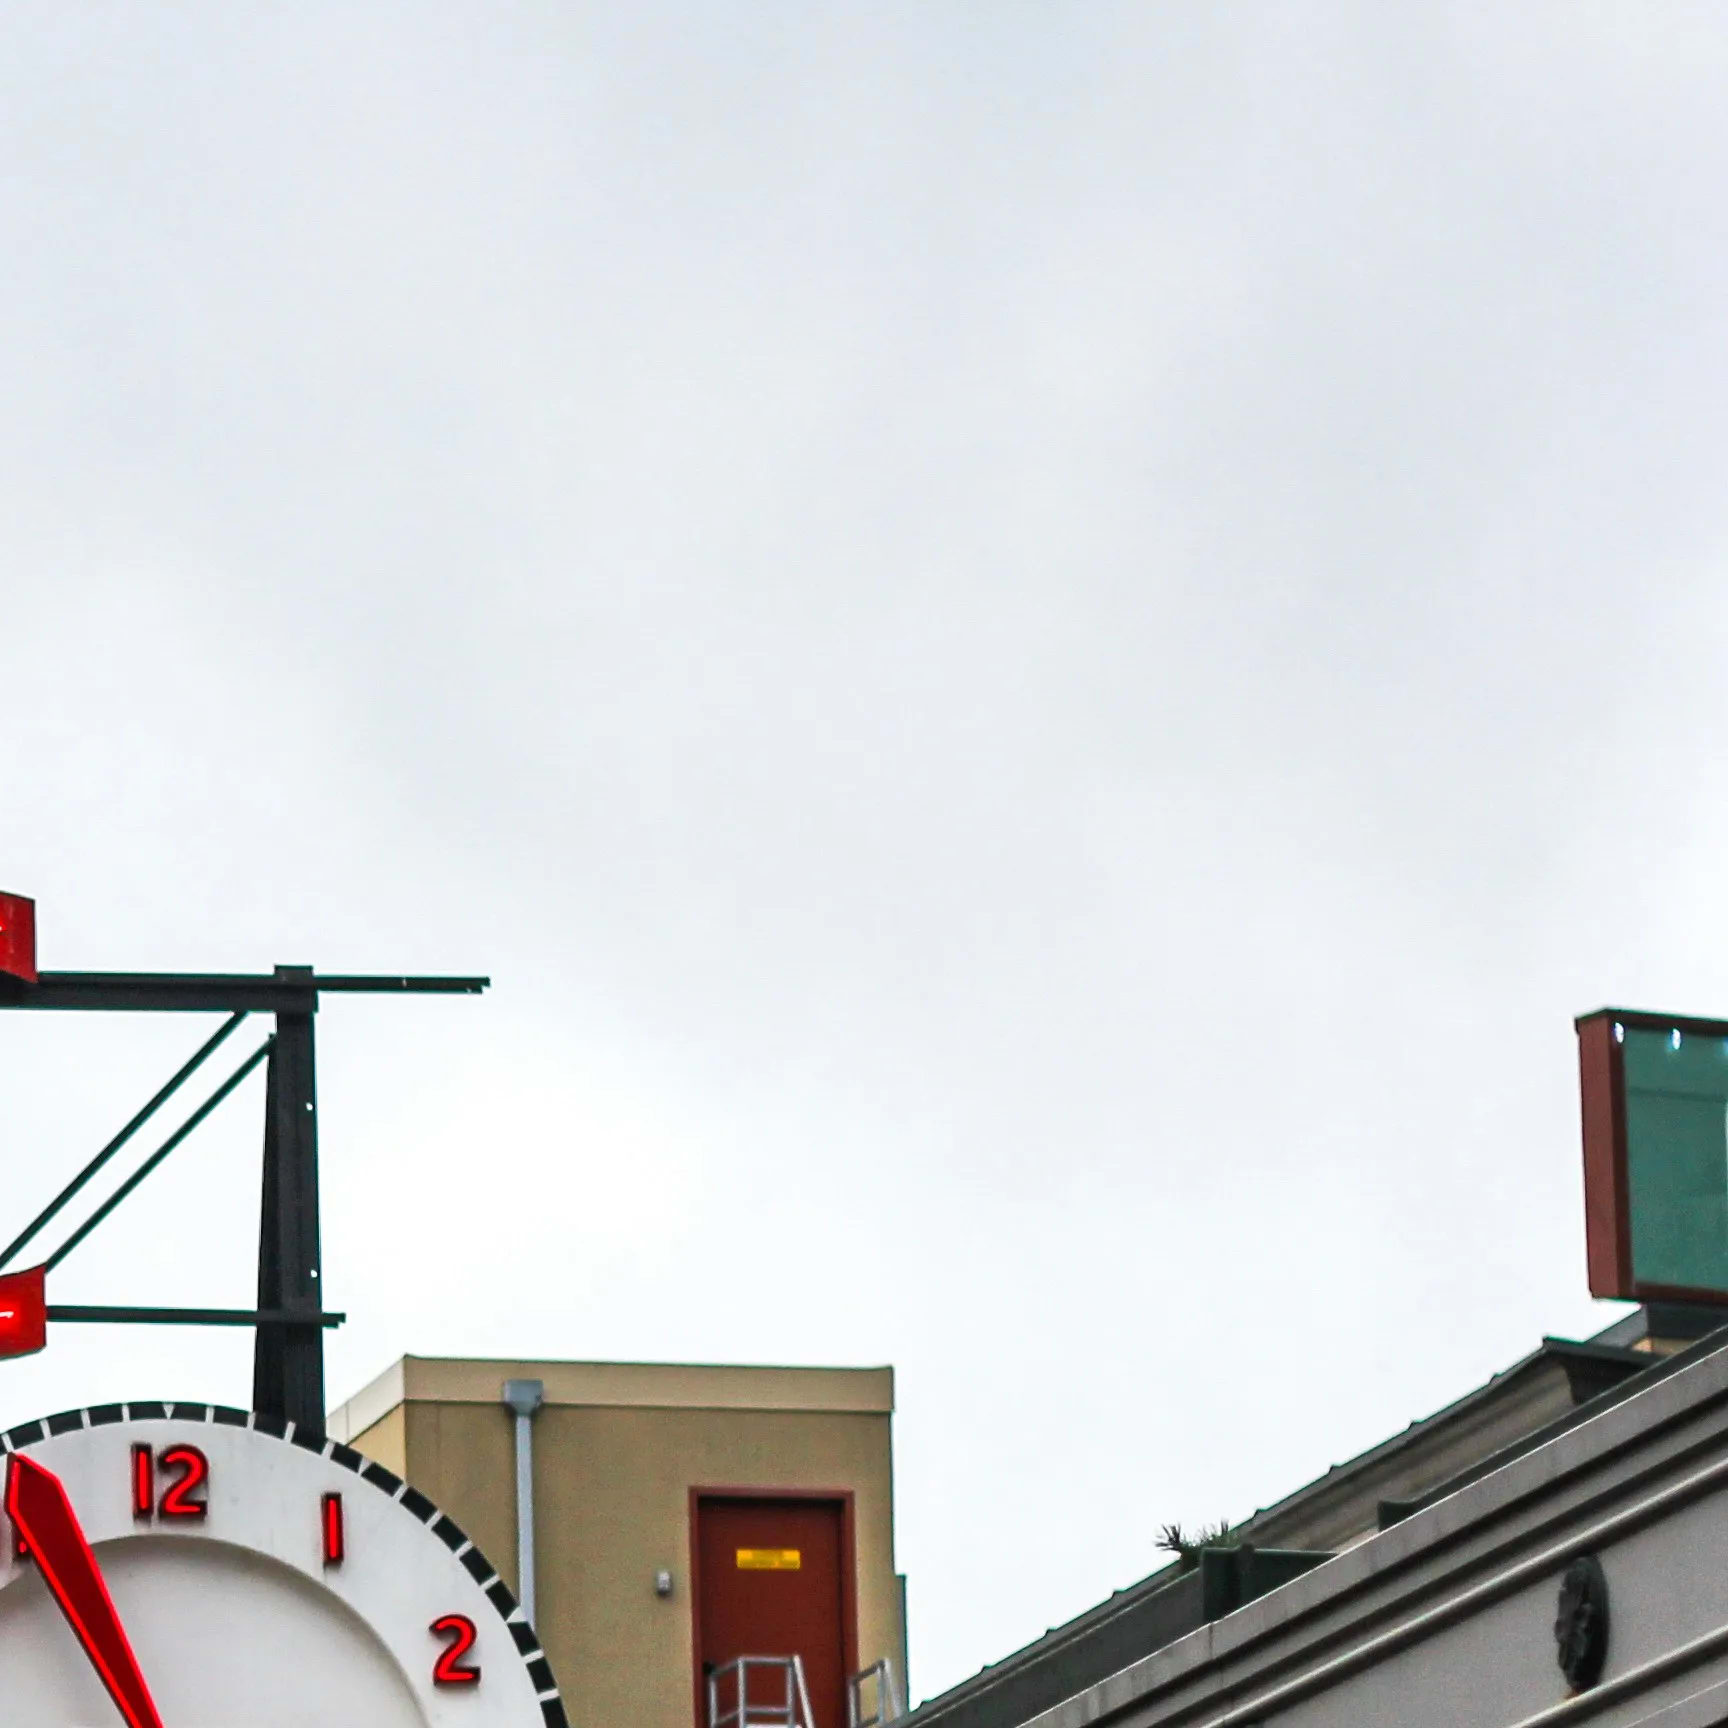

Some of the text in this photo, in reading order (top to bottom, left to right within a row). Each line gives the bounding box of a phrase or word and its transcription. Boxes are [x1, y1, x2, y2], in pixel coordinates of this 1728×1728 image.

[129, 1442, 210, 1520] 12
[321, 1491, 345, 1565] 1
[429, 1613, 482, 1686] 2
